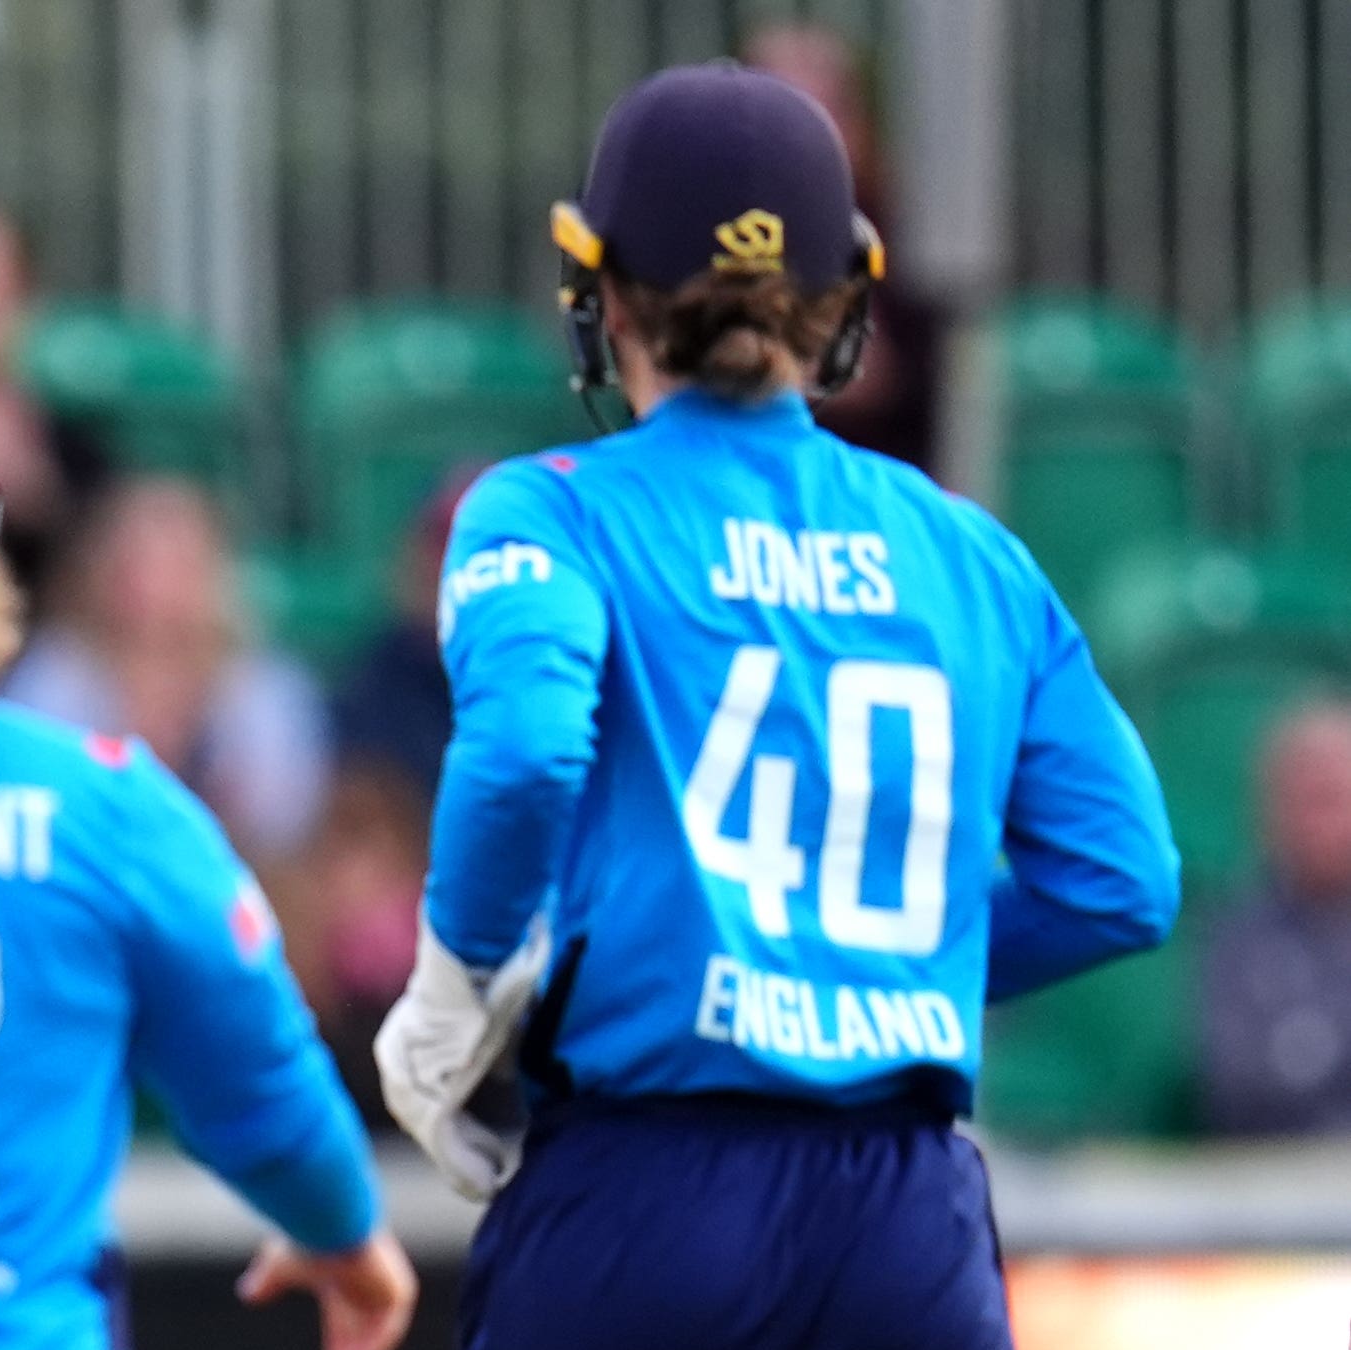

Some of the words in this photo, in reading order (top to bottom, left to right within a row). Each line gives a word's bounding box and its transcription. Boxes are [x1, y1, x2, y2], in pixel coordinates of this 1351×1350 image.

[710, 518, 896, 617] JONES
[682, 644, 953, 958] 40
[696, 953, 965, 1060] ENGLAND
